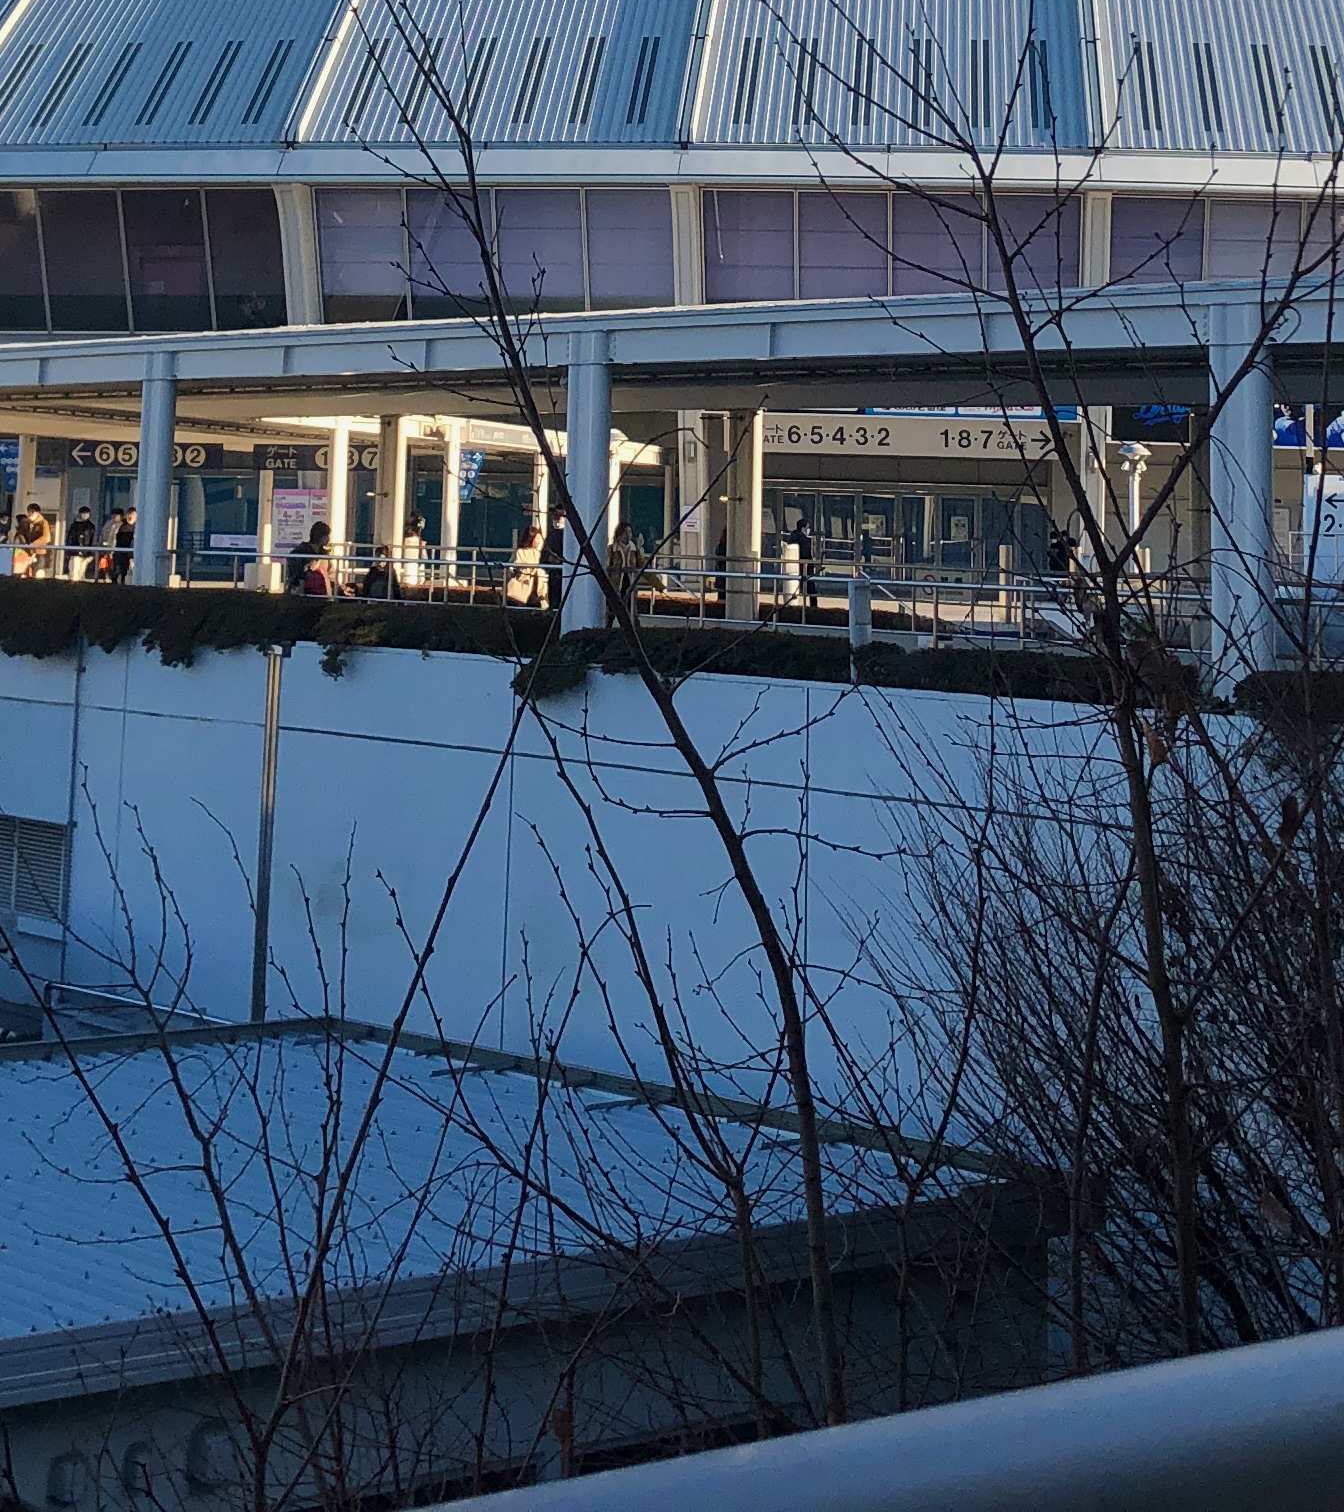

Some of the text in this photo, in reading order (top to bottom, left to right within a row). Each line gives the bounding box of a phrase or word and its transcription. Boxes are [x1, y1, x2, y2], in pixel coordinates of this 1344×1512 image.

[763, 424, 784, 435] ート
[763, 434, 784, 444] ATE
[265, 458, 297, 469] GATE
